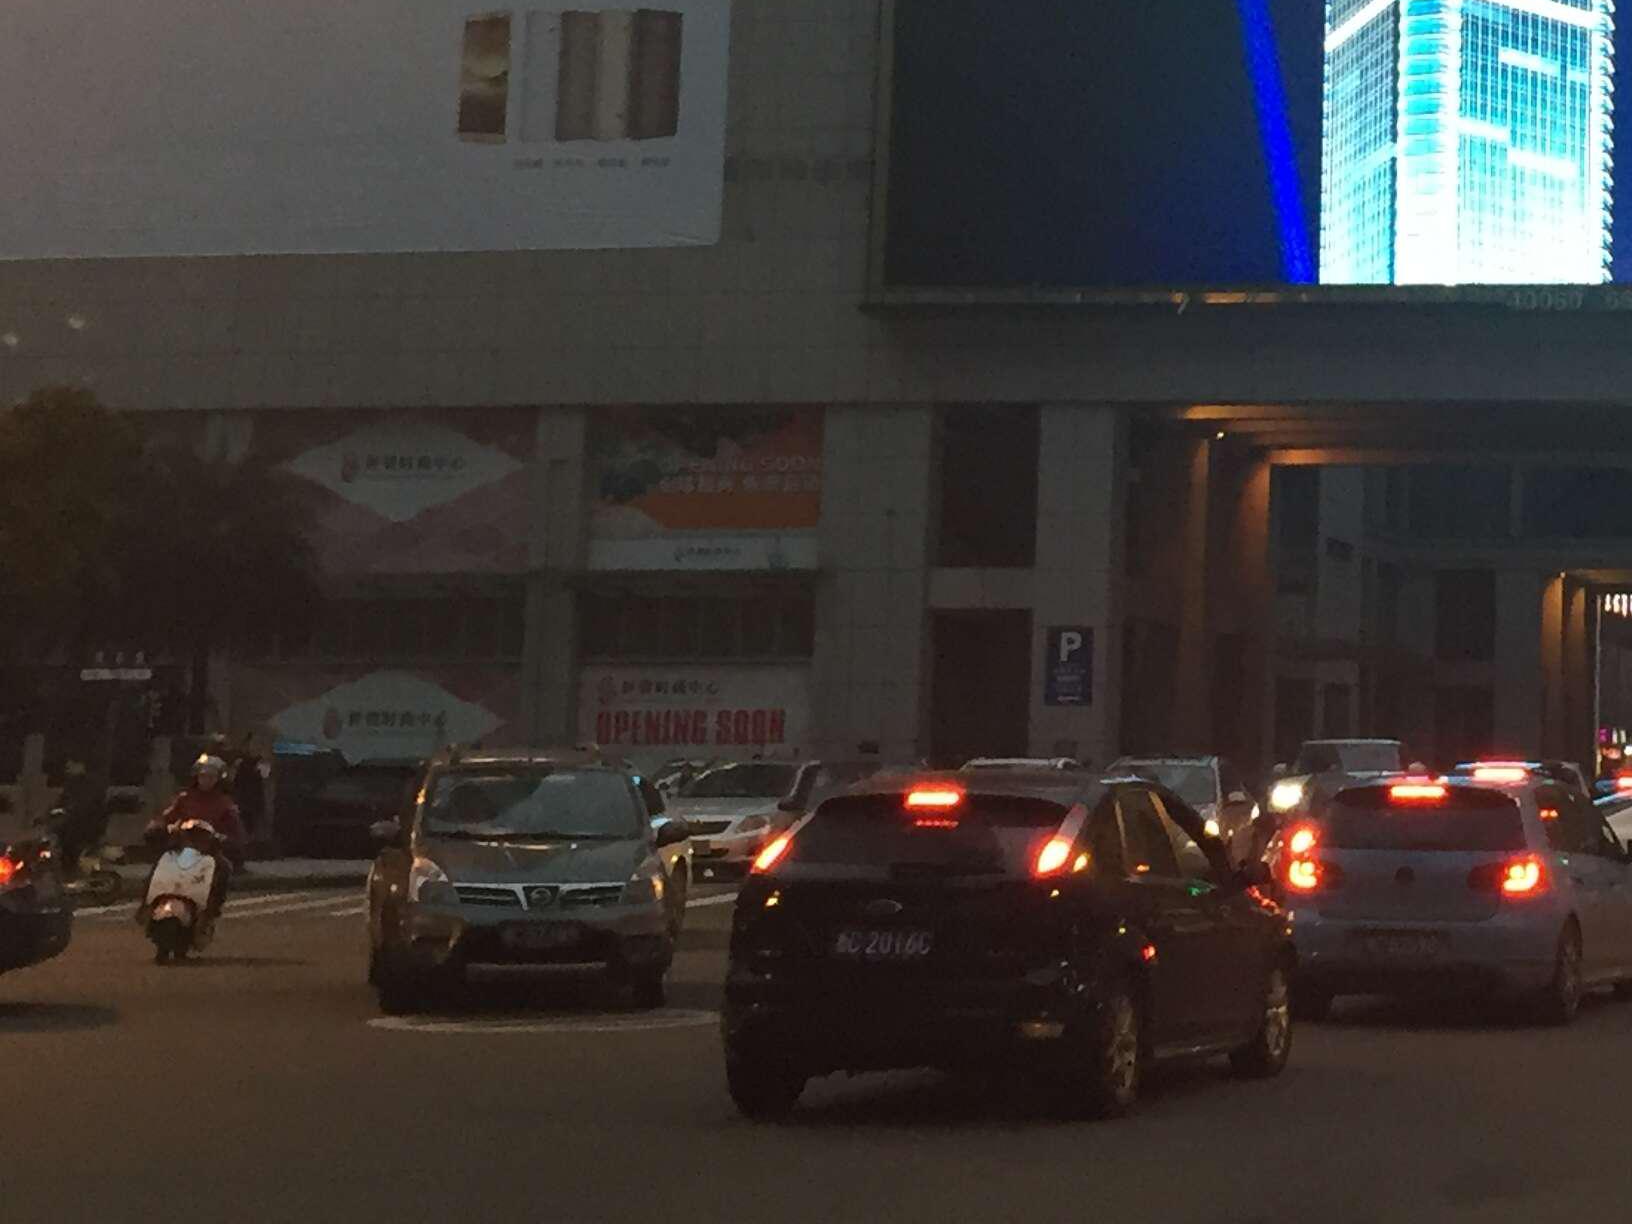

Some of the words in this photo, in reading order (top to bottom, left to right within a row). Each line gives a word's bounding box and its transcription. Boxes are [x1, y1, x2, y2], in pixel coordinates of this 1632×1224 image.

[1060, 631, 1083, 662] P
[596, 709, 707, 745] OPENING
[716, 709, 786, 745] SOON
